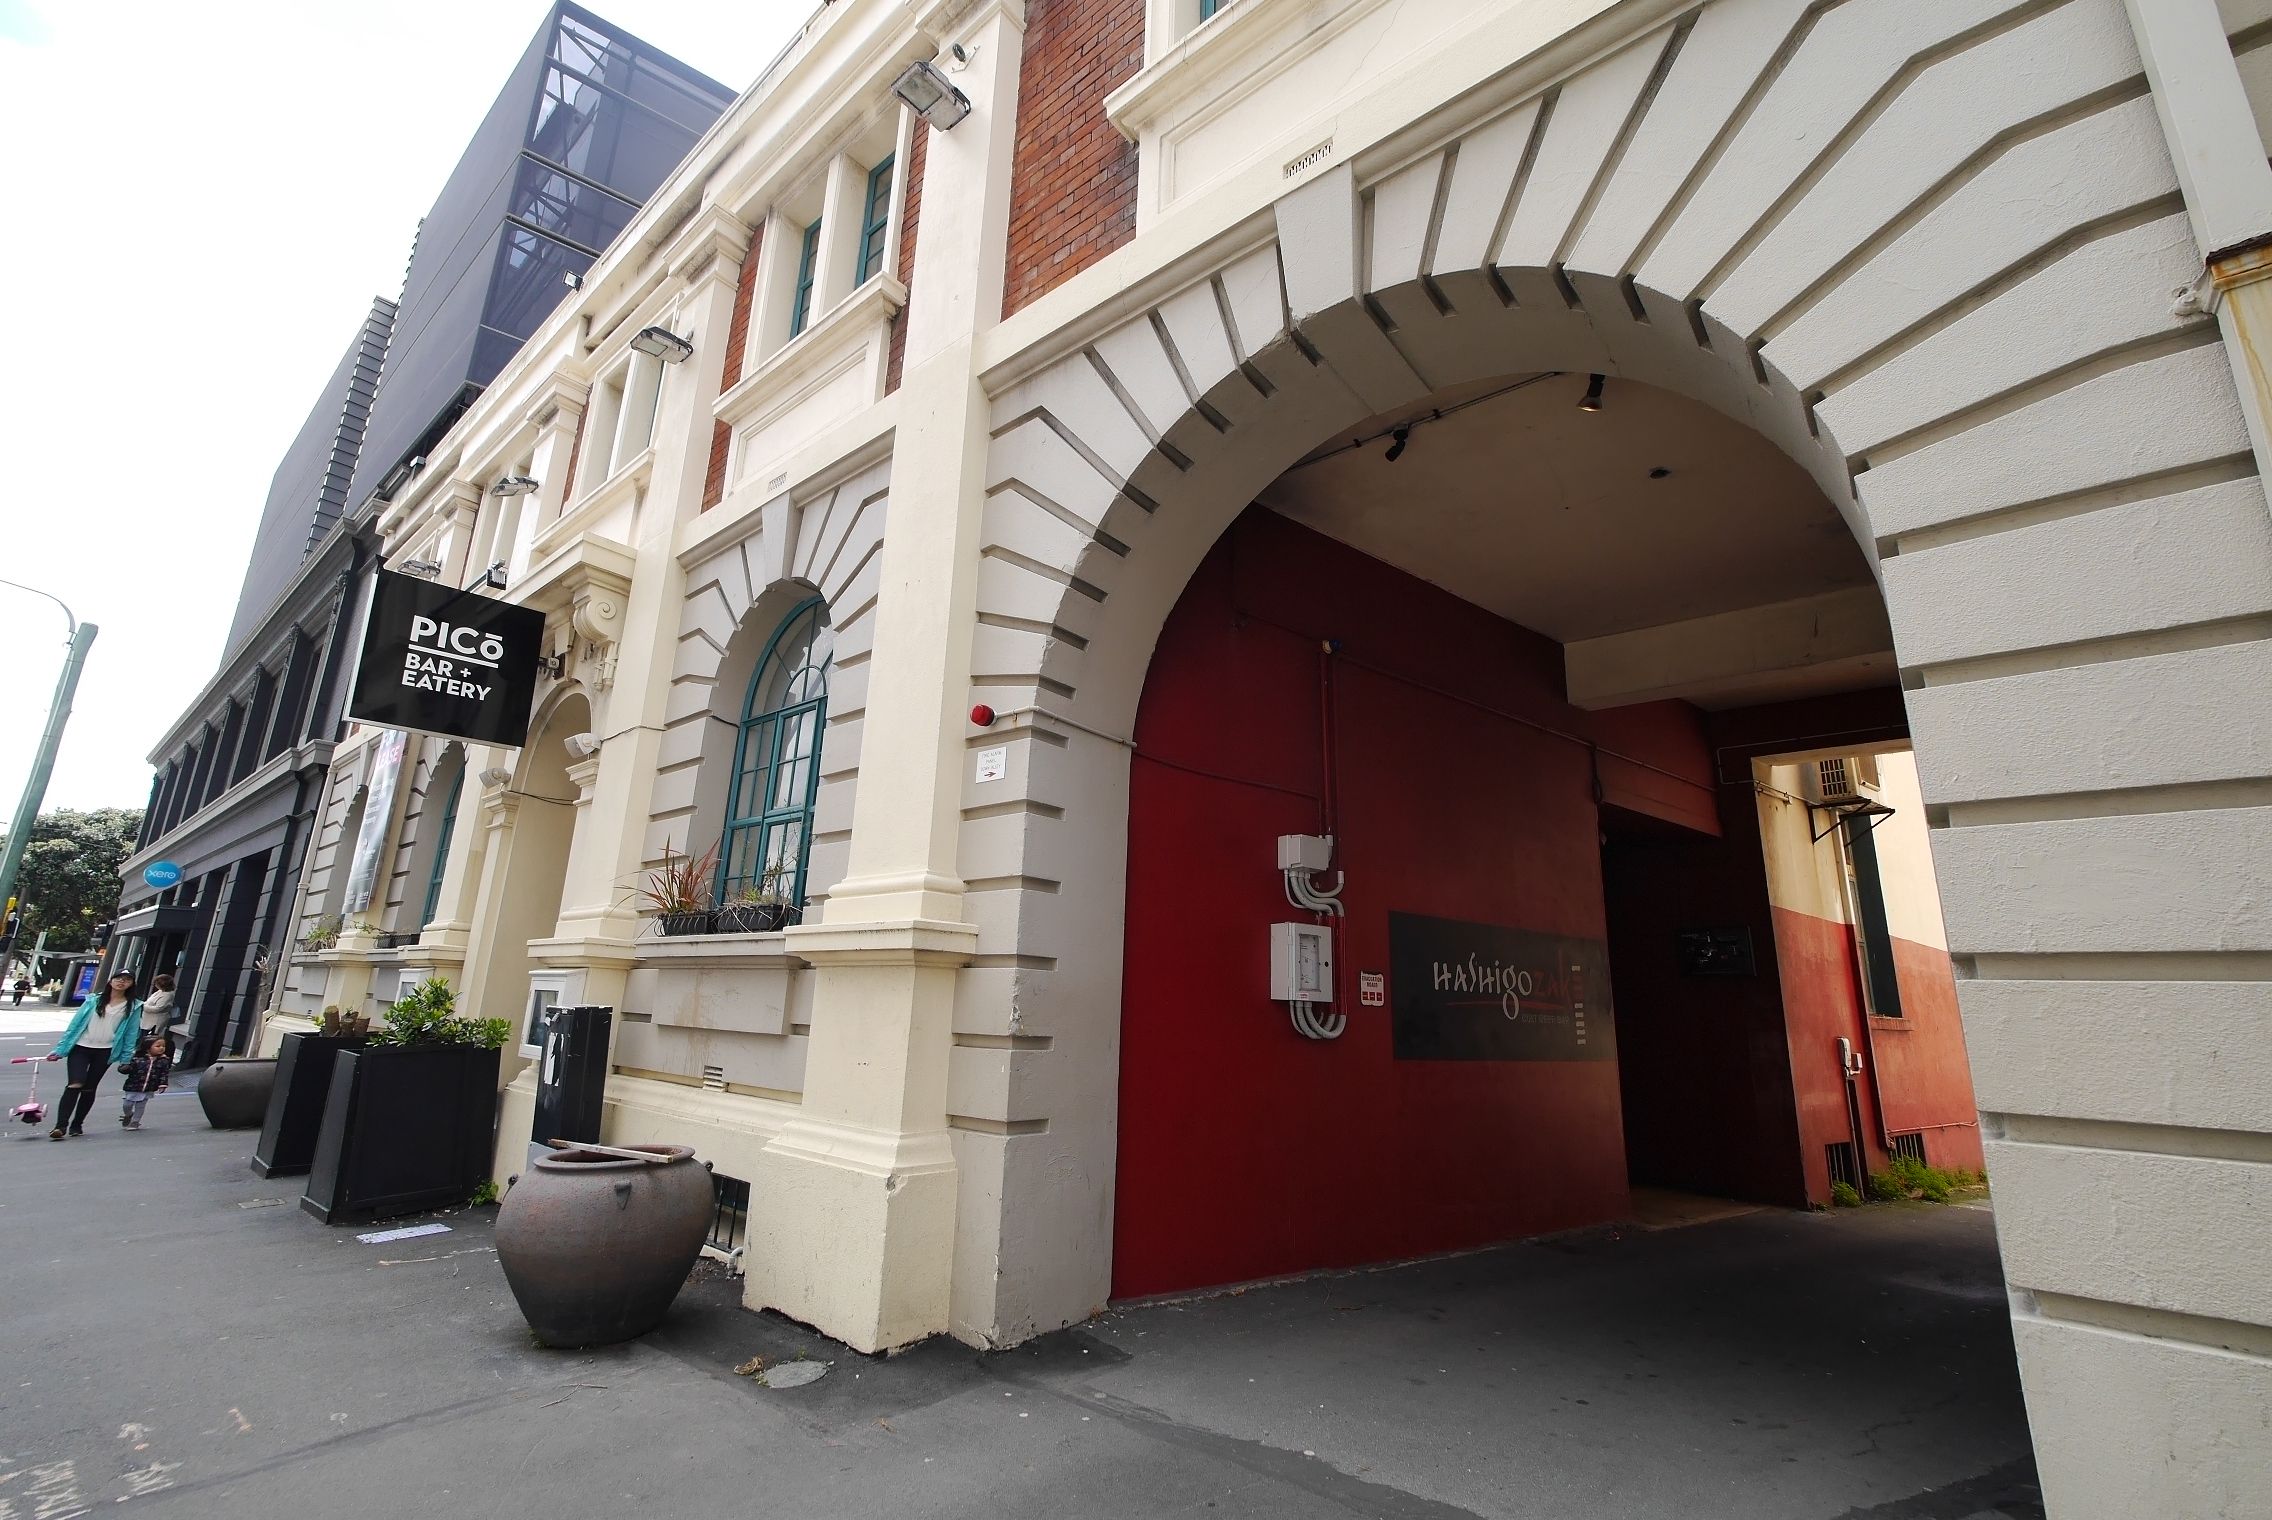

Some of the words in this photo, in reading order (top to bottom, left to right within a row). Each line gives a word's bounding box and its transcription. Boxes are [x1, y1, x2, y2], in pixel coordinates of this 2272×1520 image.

[404, 652, 454, 677] BAR
[460, 667, 471, 678] +
[401, 670, 492, 701] EATERY
[148, 869, 176, 879] xero
